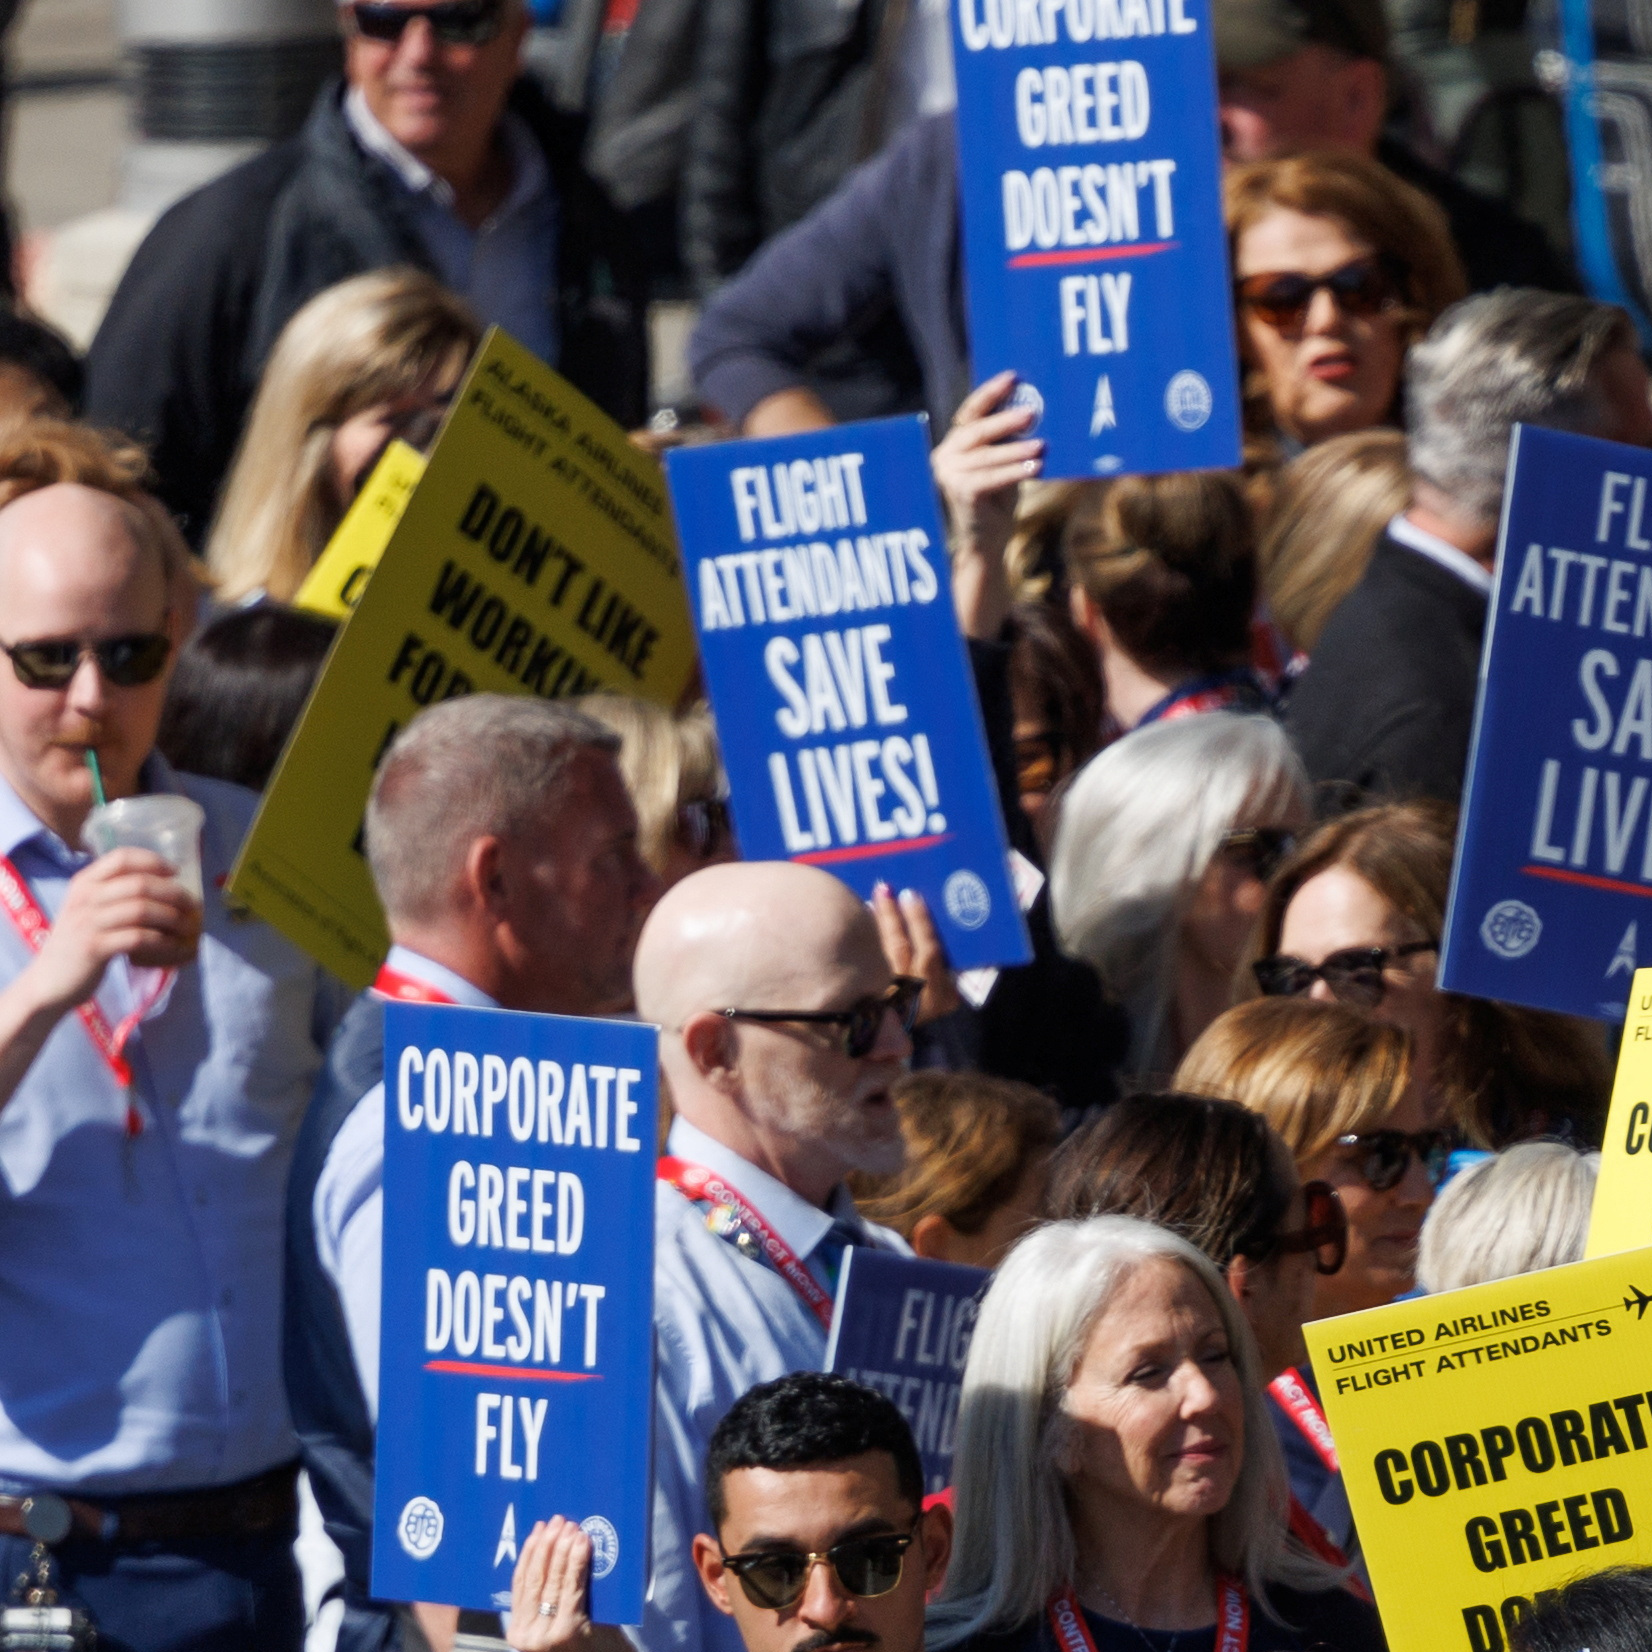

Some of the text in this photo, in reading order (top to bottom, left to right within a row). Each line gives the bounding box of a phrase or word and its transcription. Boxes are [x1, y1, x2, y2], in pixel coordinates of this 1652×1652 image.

[1016, 61, 1149, 148] GREED
[1002, 159, 1175, 250] DOESN'T
[1060, 273, 1131, 355] FLY
[731, 453, 867, 541] FLIGHT
[458, 484, 583, 600] DON'T
[575, 579, 659, 679] LIKE
[700, 529, 937, 629] ATTENDANTS
[765, 624, 907, 738] SAVE
[769, 734, 946, 851] LIVES!
[398, 1046, 640, 1152] CORPORATE
[449, 1161, 584, 1255] GREED
[704, 1179, 789, 1272] CONTRACT
[426, 1269, 605, 1368] DOESN'T
[1328, 1301, 1550, 1363] UNITED AIRLINES
[1336, 1320, 1611, 1395] FLIGHT ATTENDANTS
[476, 1393, 548, 1481] FLY
[1465, 1488, 1633, 1572] GREED
